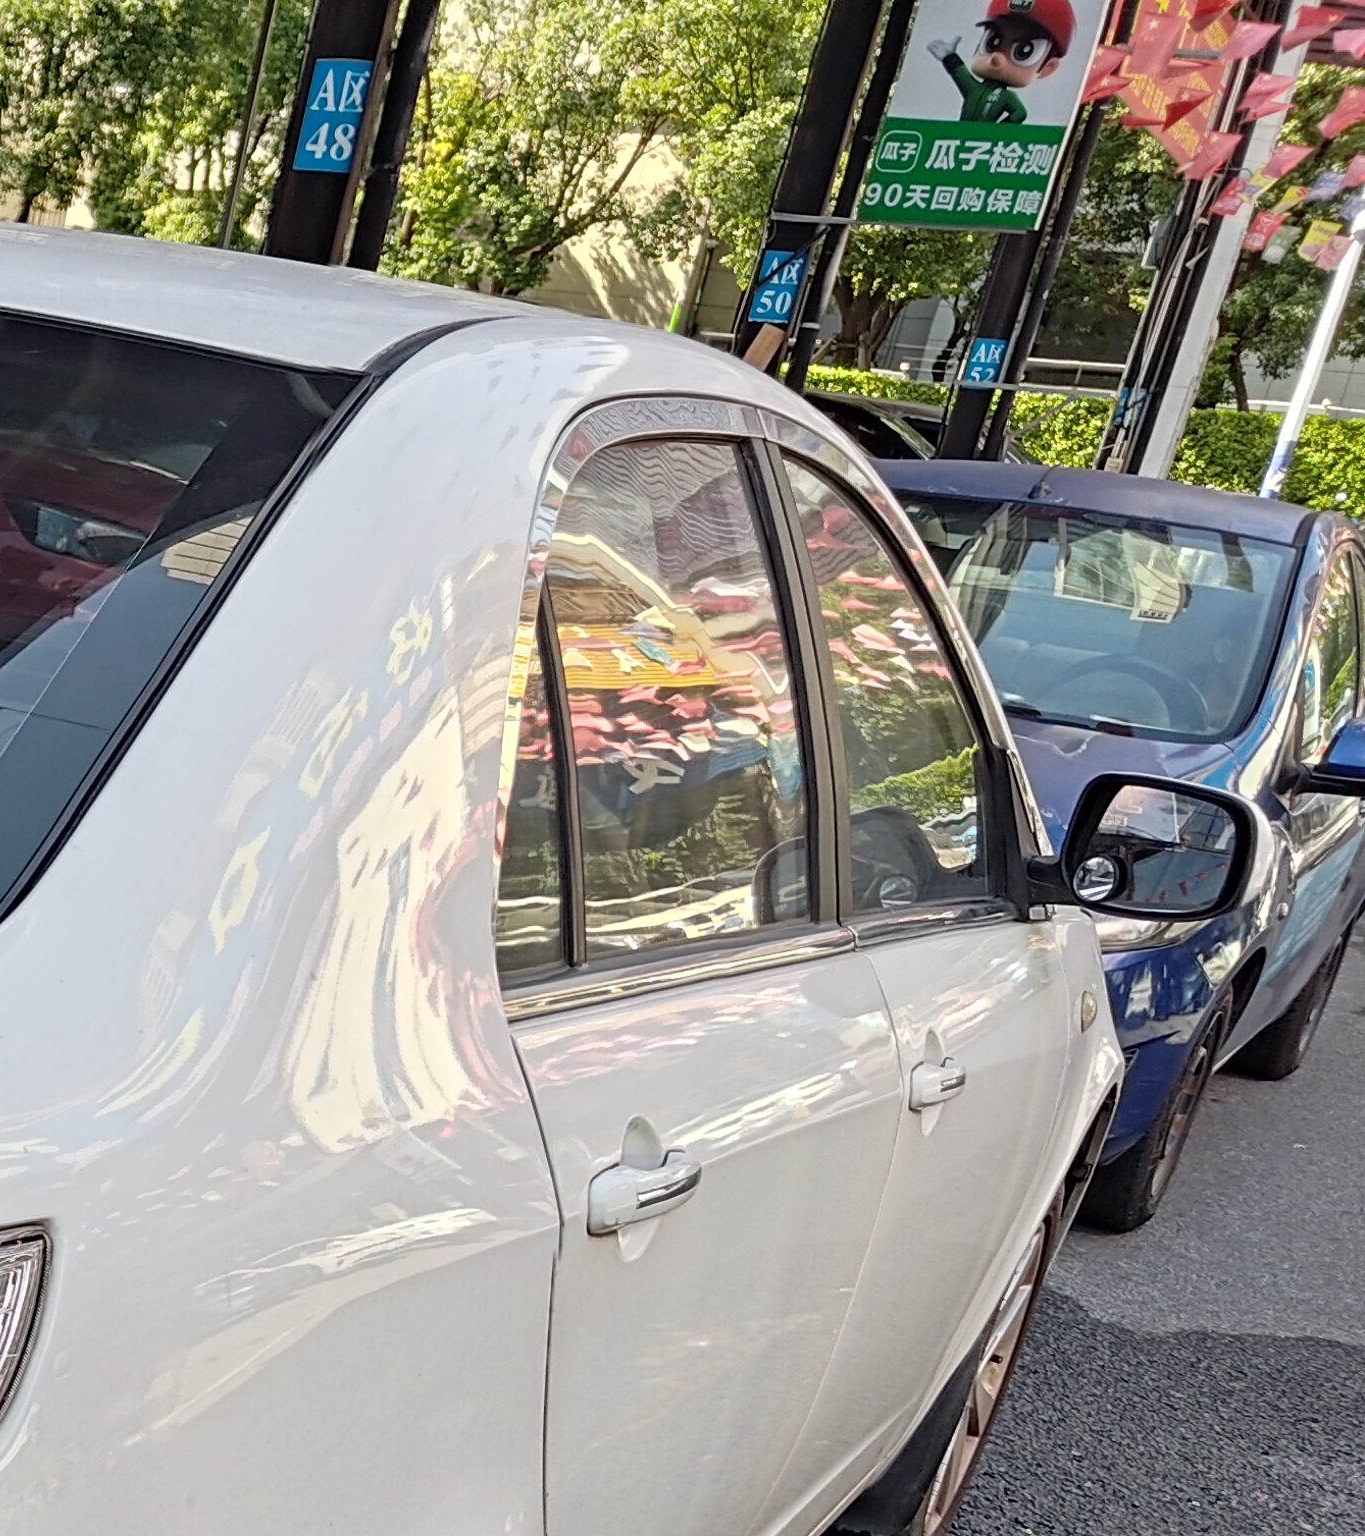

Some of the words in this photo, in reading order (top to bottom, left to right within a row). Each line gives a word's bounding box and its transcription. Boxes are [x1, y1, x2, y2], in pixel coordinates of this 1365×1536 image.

[310, 67, 370, 112] A区
[305, 122, 356, 161] 48
[880, 142, 917, 162] 瓜子
[924, 139, 1058, 176] 瓜子检测
[863, 183, 1043, 216] 90天回购保障
[763, 256, 803, 285] A区
[756, 290, 792, 315] 50
[971, 342, 1005, 364] A区
[969, 366, 996, 383] 52
